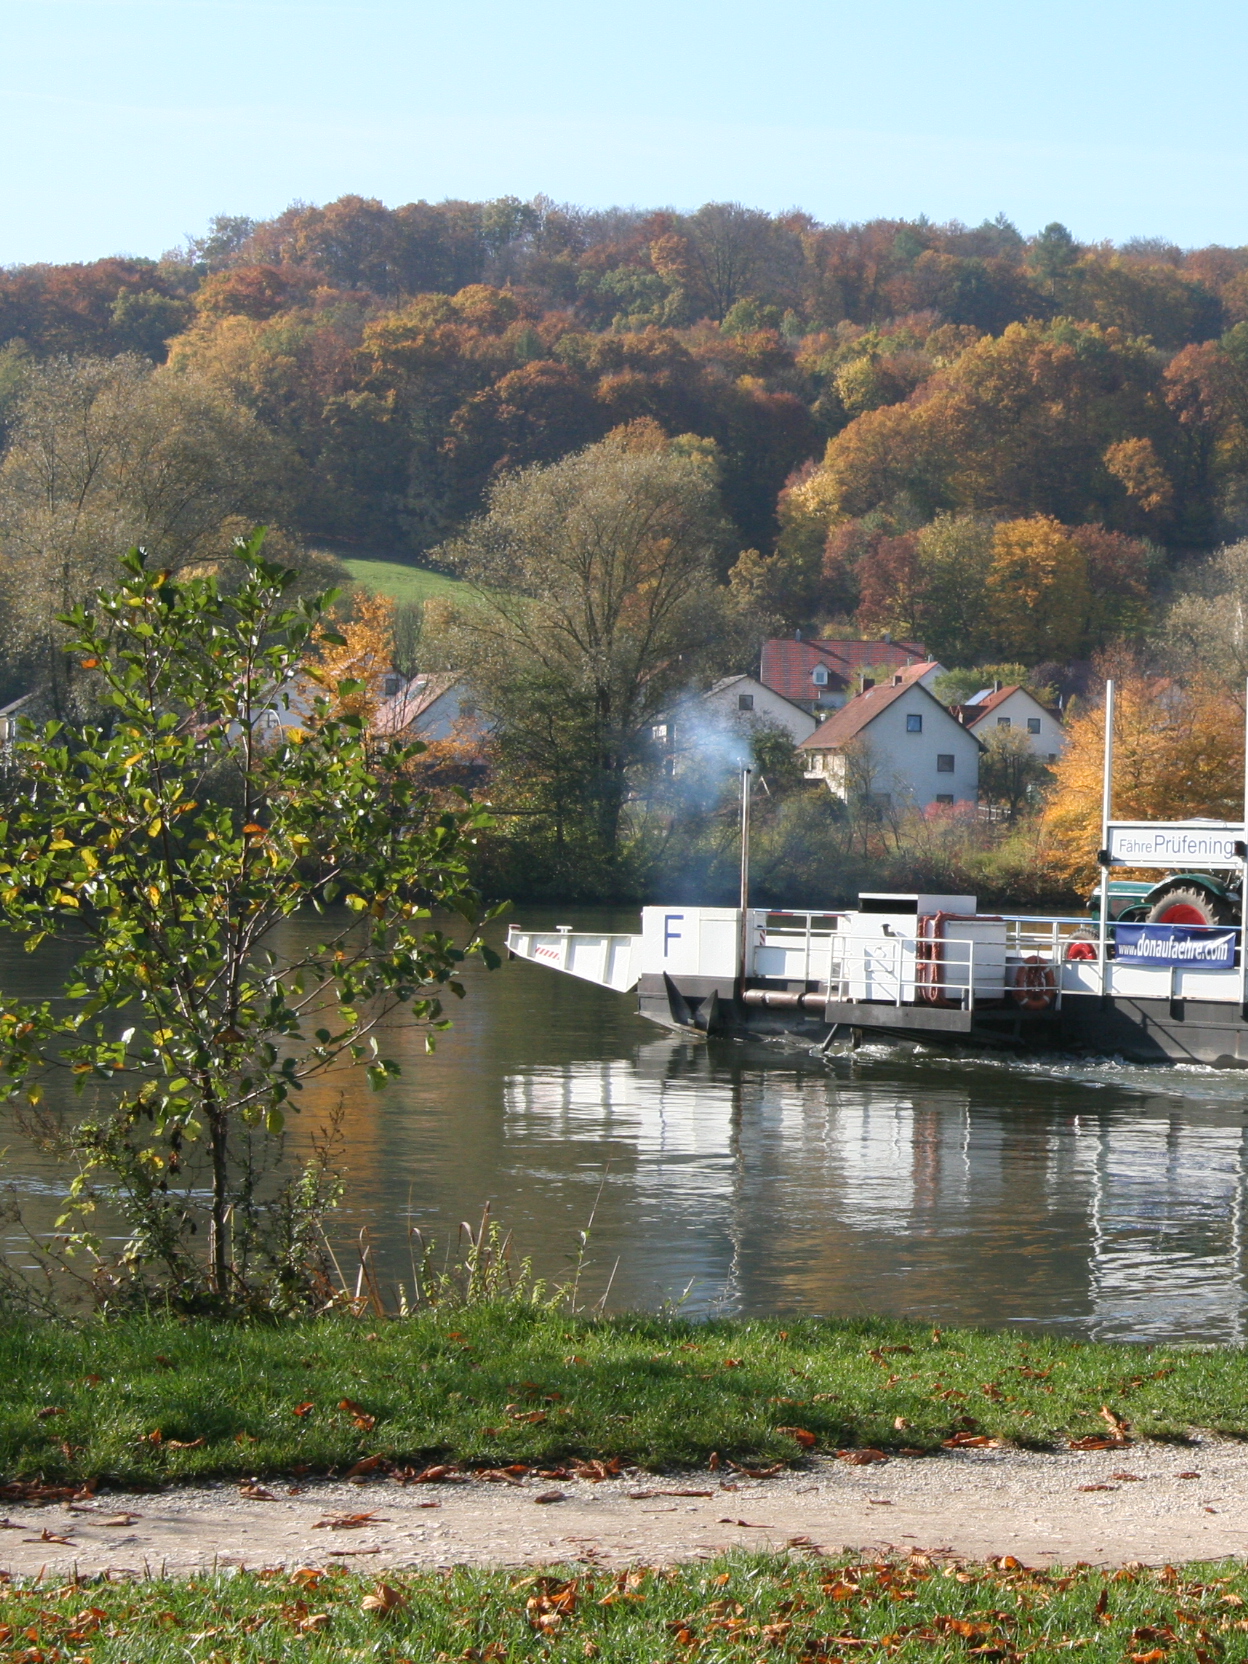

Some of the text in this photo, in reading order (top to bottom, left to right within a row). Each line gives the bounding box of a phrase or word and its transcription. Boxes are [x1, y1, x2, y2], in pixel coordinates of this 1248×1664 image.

[1119, 835, 1235, 859] Fähre Prüfening
[664, 915, 684, 957] F
[1118, 933, 1228, 960] www.donaufaehre.com
